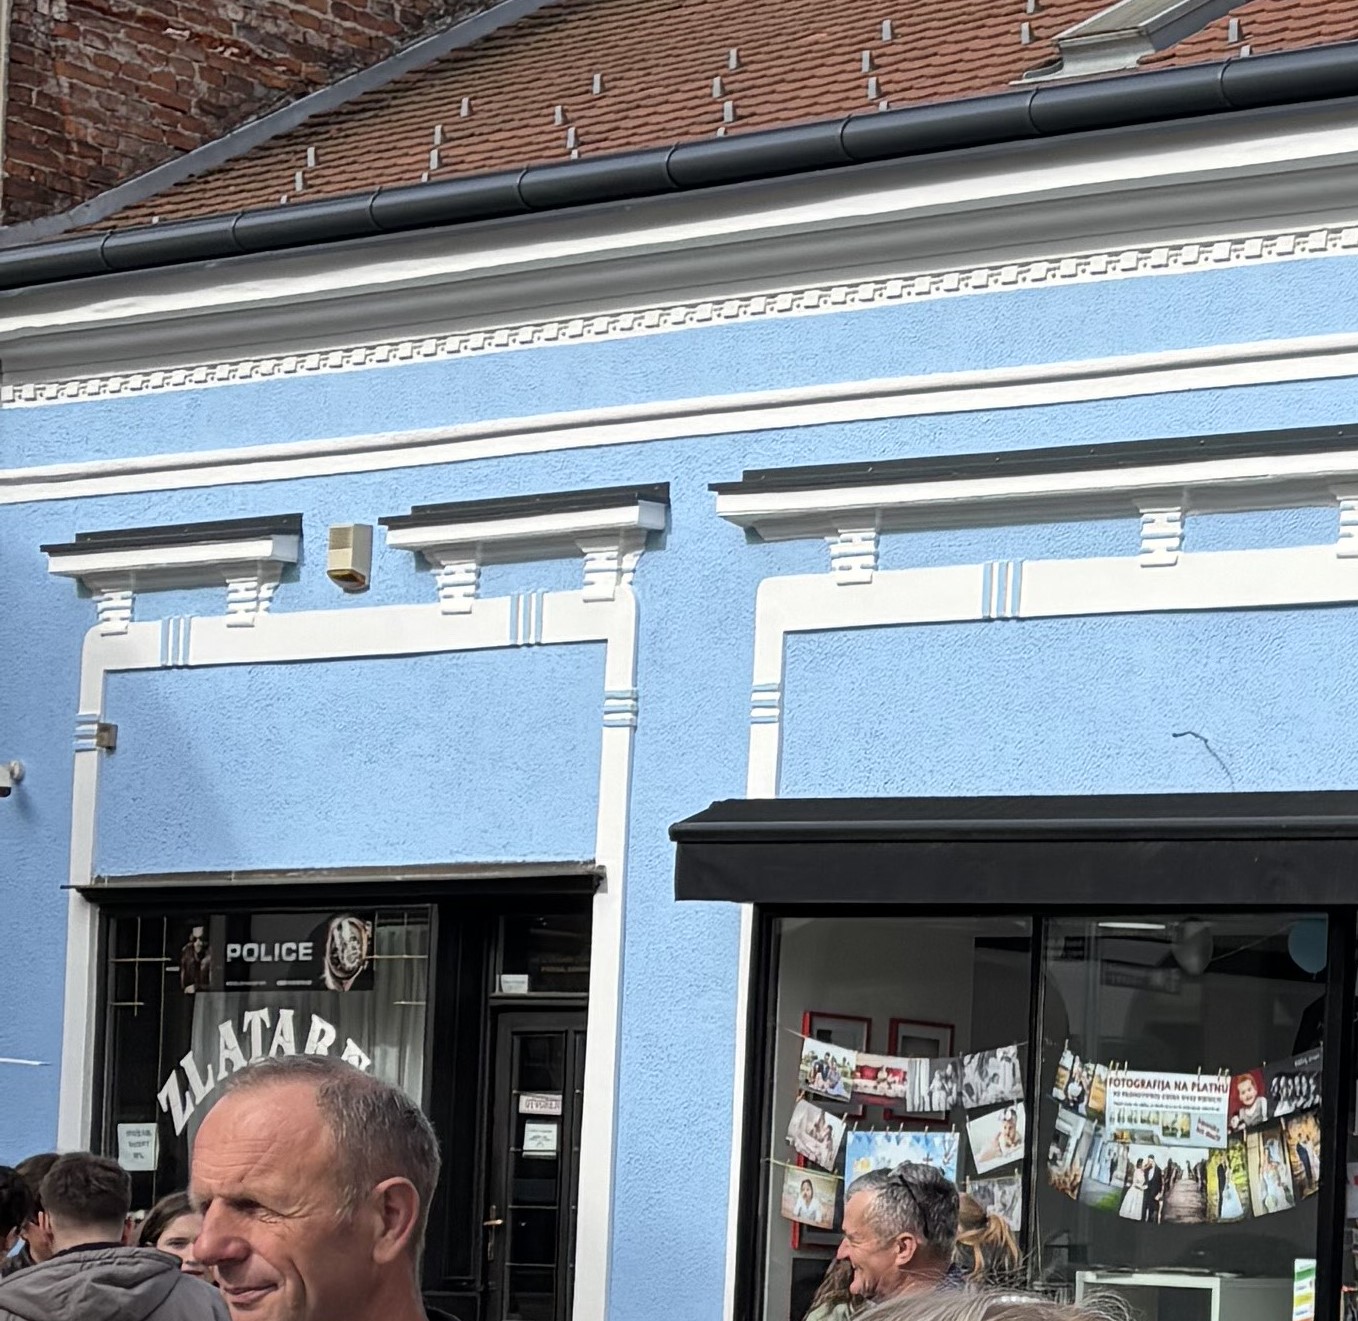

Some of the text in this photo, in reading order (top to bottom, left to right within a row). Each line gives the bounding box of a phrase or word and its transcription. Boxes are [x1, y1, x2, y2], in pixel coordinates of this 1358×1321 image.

[226, 942, 314, 962] POLICE
[1108, 1077, 1229, 1094] FOTOGRAFIJA NA PLATNU
